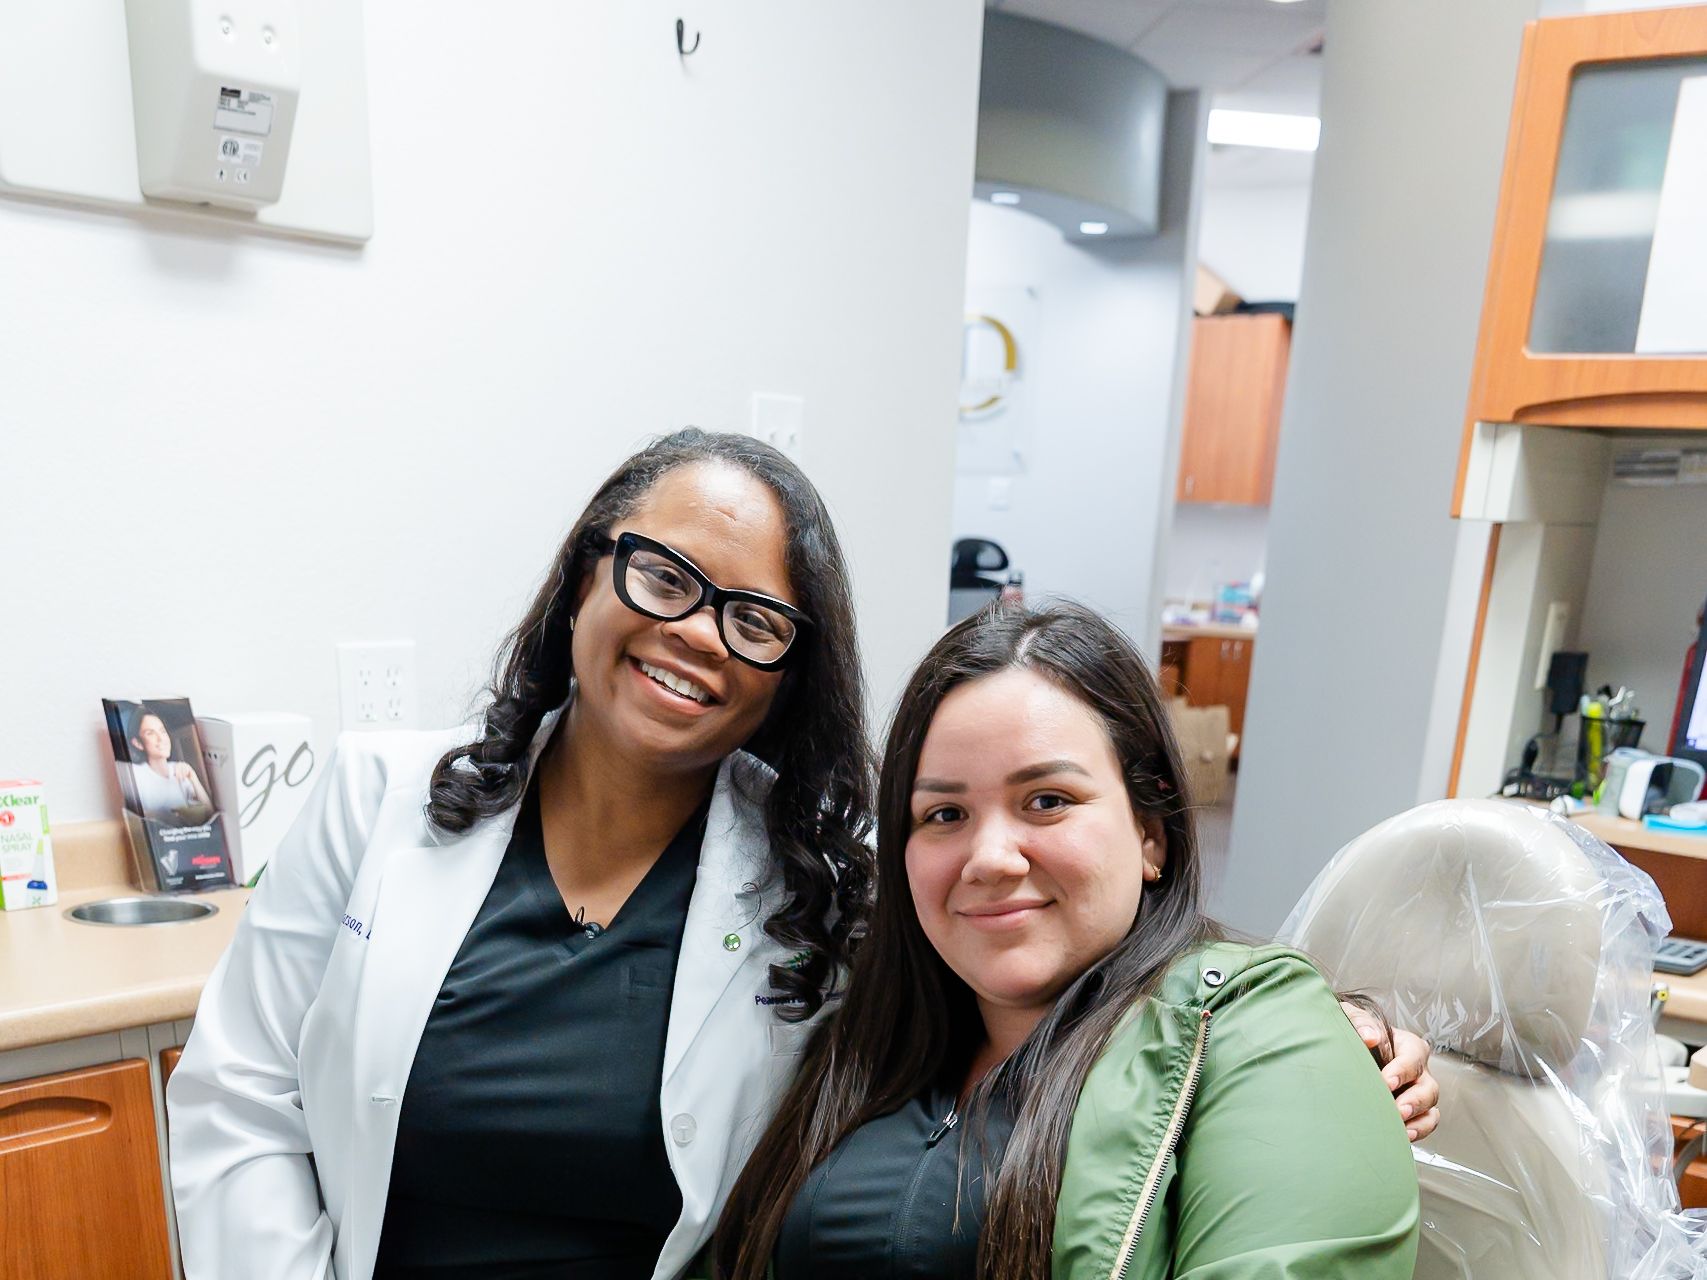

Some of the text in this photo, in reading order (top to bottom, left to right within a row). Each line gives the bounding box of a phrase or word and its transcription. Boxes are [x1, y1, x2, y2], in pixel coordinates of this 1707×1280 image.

[240, 740, 315, 830] go
[1, 831, 33, 843] NASAL
[2, 843, 32, 854] SPRAY
